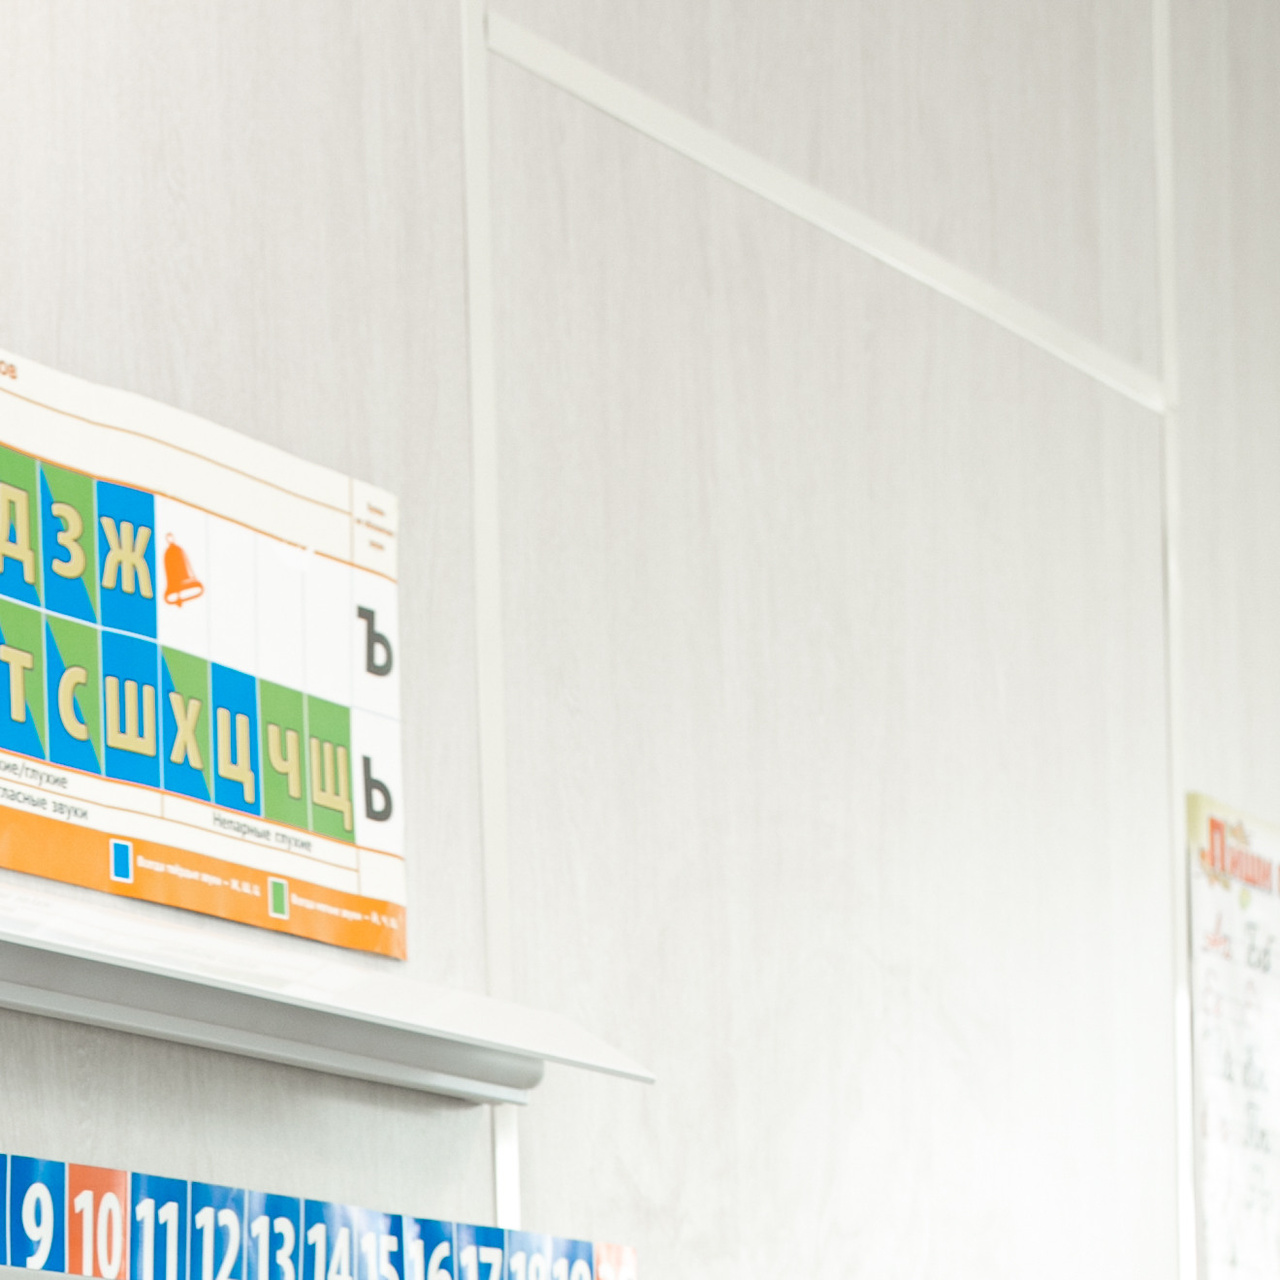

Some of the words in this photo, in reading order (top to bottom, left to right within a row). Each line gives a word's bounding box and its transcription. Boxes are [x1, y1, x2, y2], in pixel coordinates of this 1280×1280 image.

[50, 501, 87, 580] з
[98, 515, 155, 600] ж
[56, 665, 88, 741] с
[105, 675, 157, 758] ш
[168, 690, 204, 770] х
[217, 706, 257, 805] ц
[268, 723, 302, 801] ч
[310, 736, 355, 832] щ
[52, 801, 88, 820] звуки
[213, 813, 271, 842] Непарные
[21, 1183, 53, 1270] 9
[73, 1189, 121, 1280] 10
